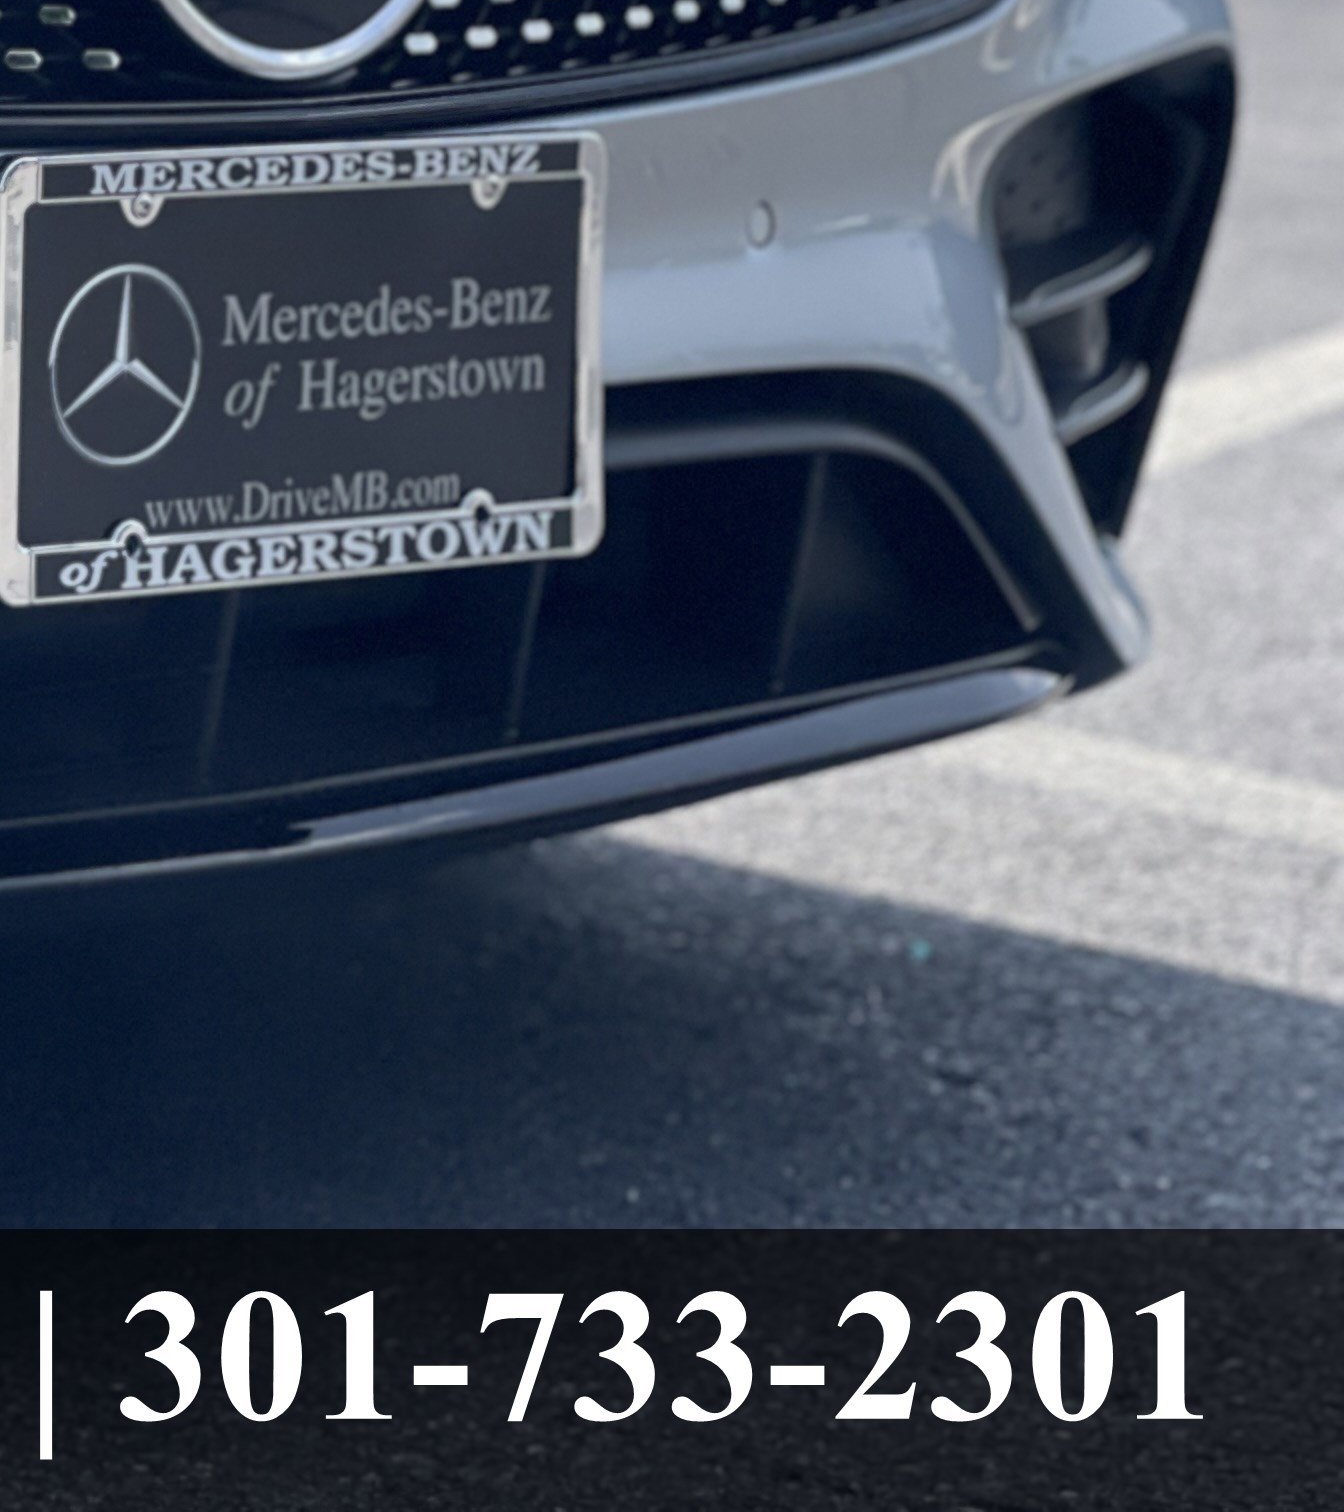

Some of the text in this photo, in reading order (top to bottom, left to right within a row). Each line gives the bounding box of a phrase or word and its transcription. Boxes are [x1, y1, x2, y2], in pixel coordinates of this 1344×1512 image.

[90, 143, 540, 195] MERCEDES-BENZ
[221, 277, 553, 346] Mercedes-Benz
[223, 353, 546, 430] of Hagerstown
[144, 469, 460, 528] www.DriveMB.com
[59, 510, 553, 594] of HAGERSTOWN
